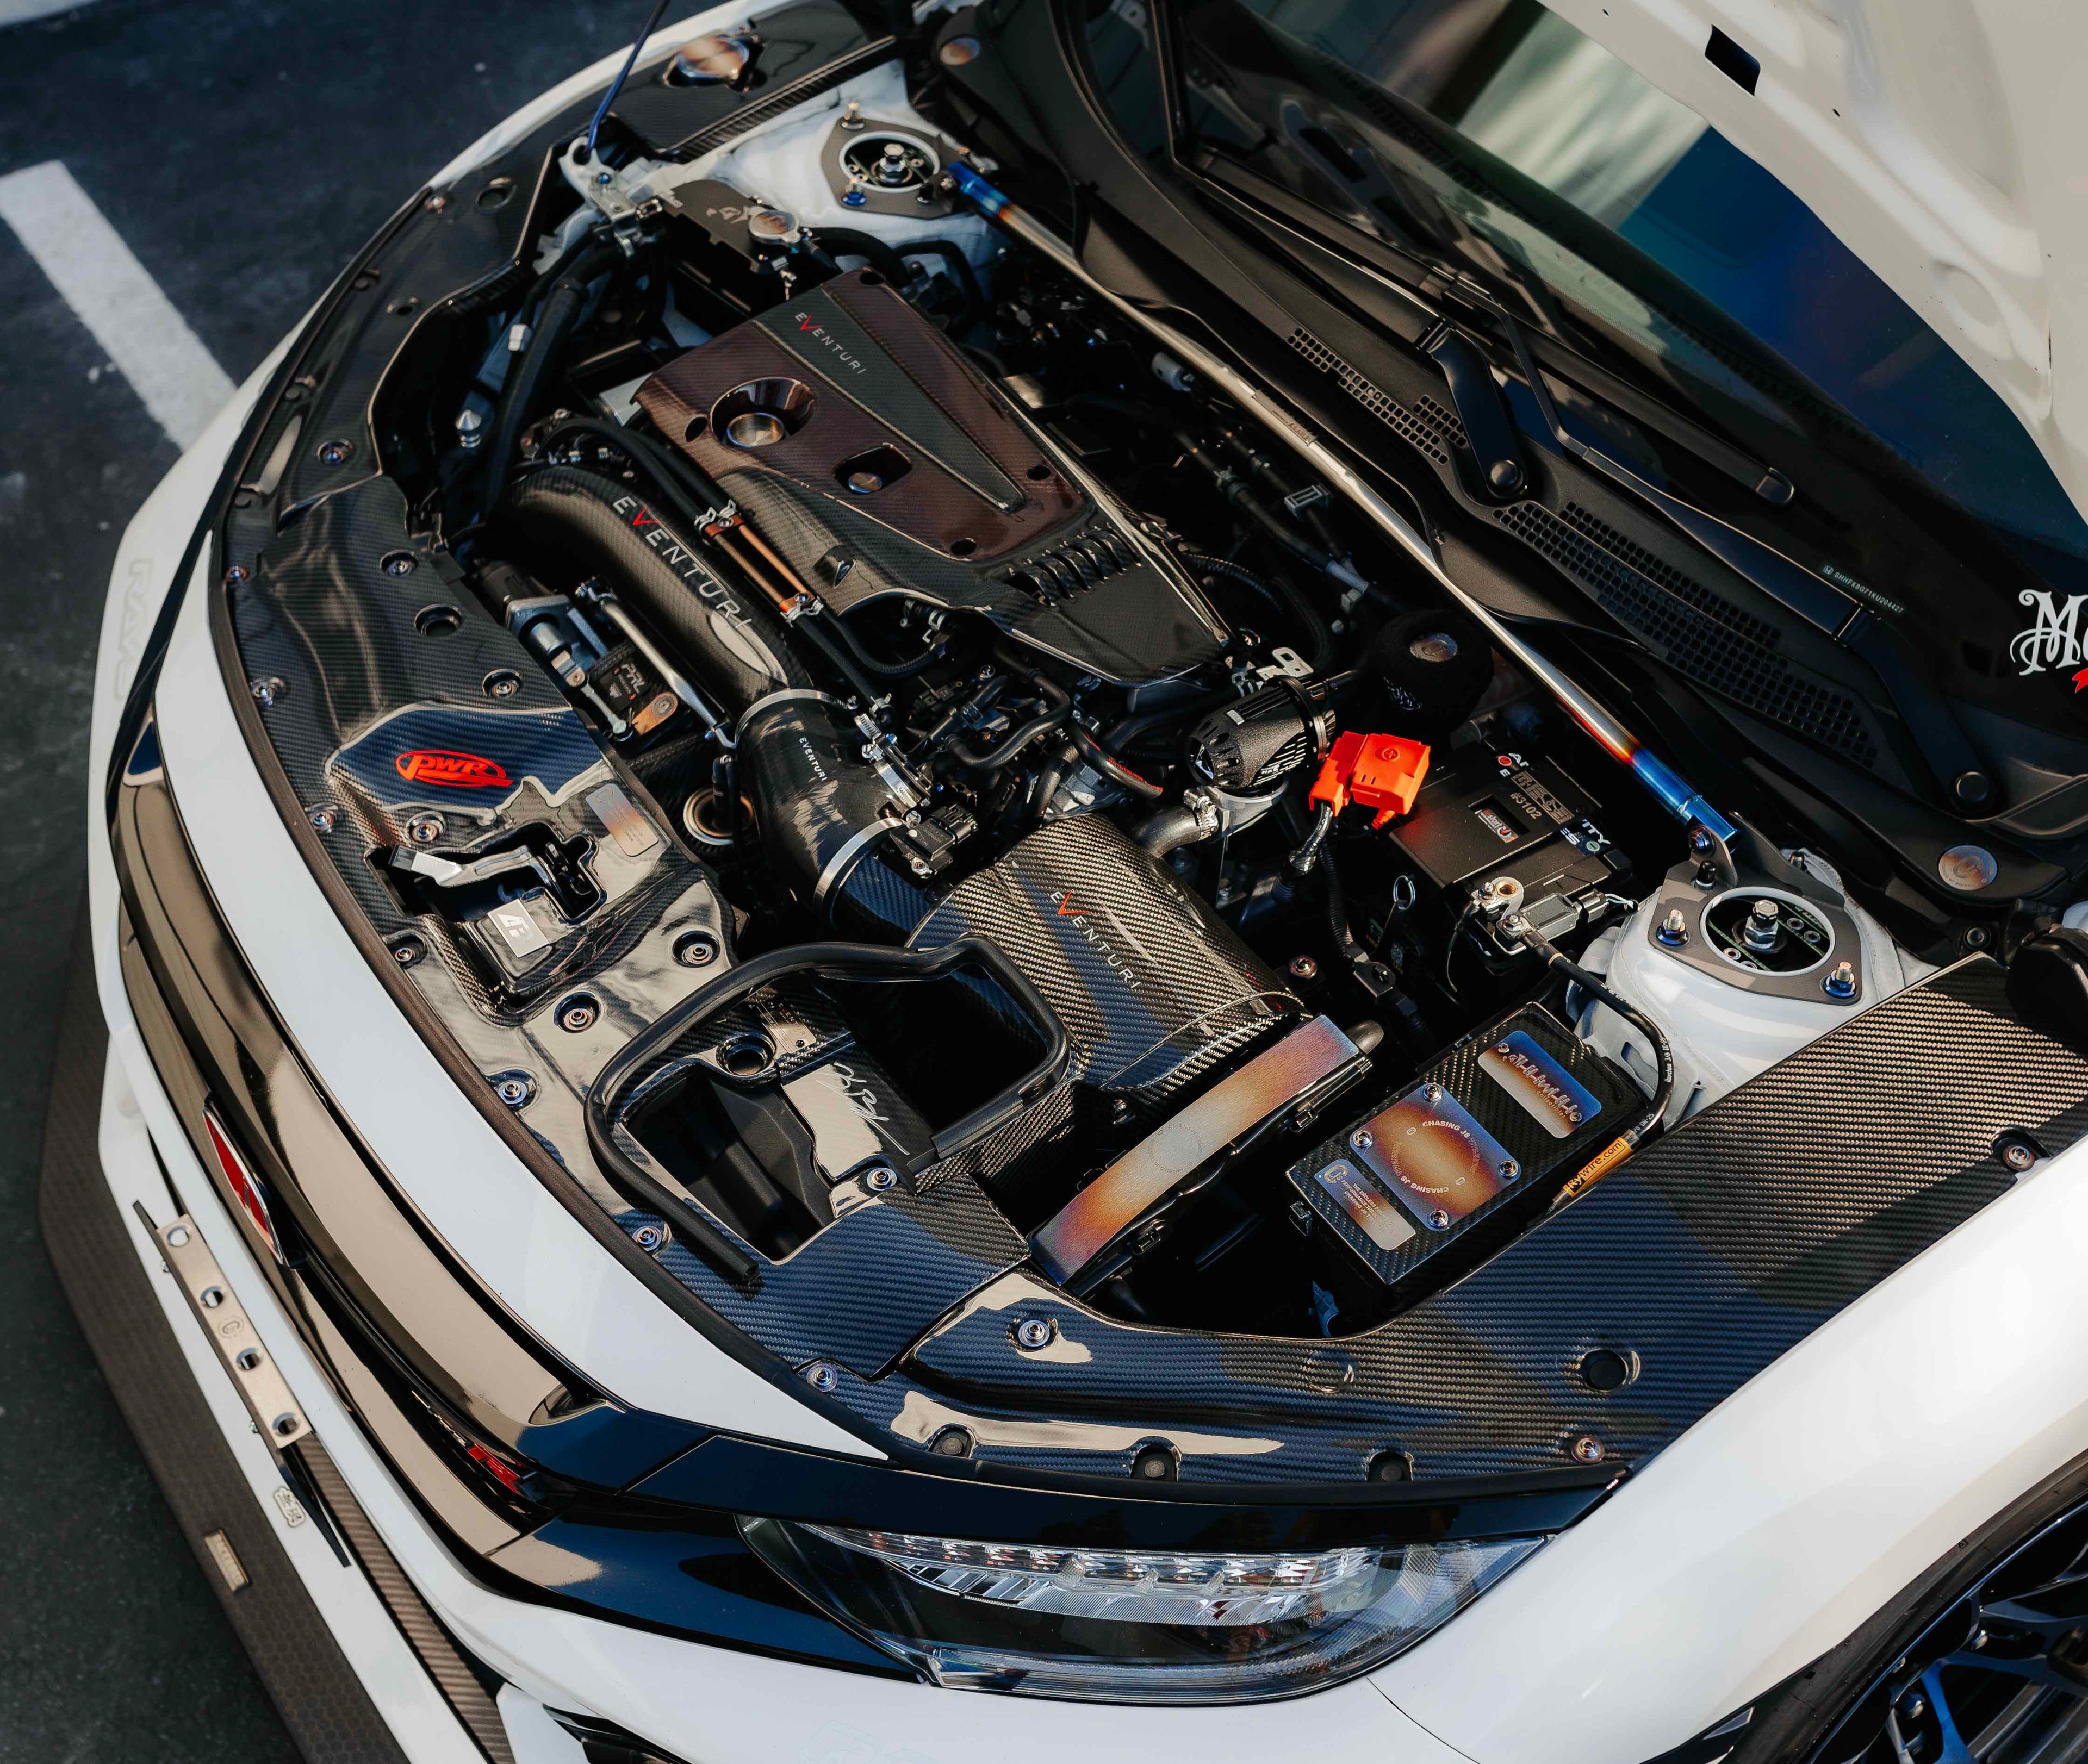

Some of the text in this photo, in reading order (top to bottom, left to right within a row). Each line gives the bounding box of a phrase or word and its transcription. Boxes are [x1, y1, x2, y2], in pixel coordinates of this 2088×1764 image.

[795, 312, 866, 375] EVENTURI
[612, 496, 752, 628] EVENTURI
[405, 753, 489, 781] PWR
[798, 737, 828, 781] EVENTURI
[1510, 792, 1542, 819] #3102
[1049, 891, 1142, 989] EVENTURI
[1422, 1120, 1461, 1131] CHASING
[1566, 1142, 1622, 1189] Rywire.com
[1341, 1180, 1368, 1208] PERFORMANCE
[1344, 1191, 1362, 1209] CHASING
[1410, 1183, 1449, 1194] CHASING
